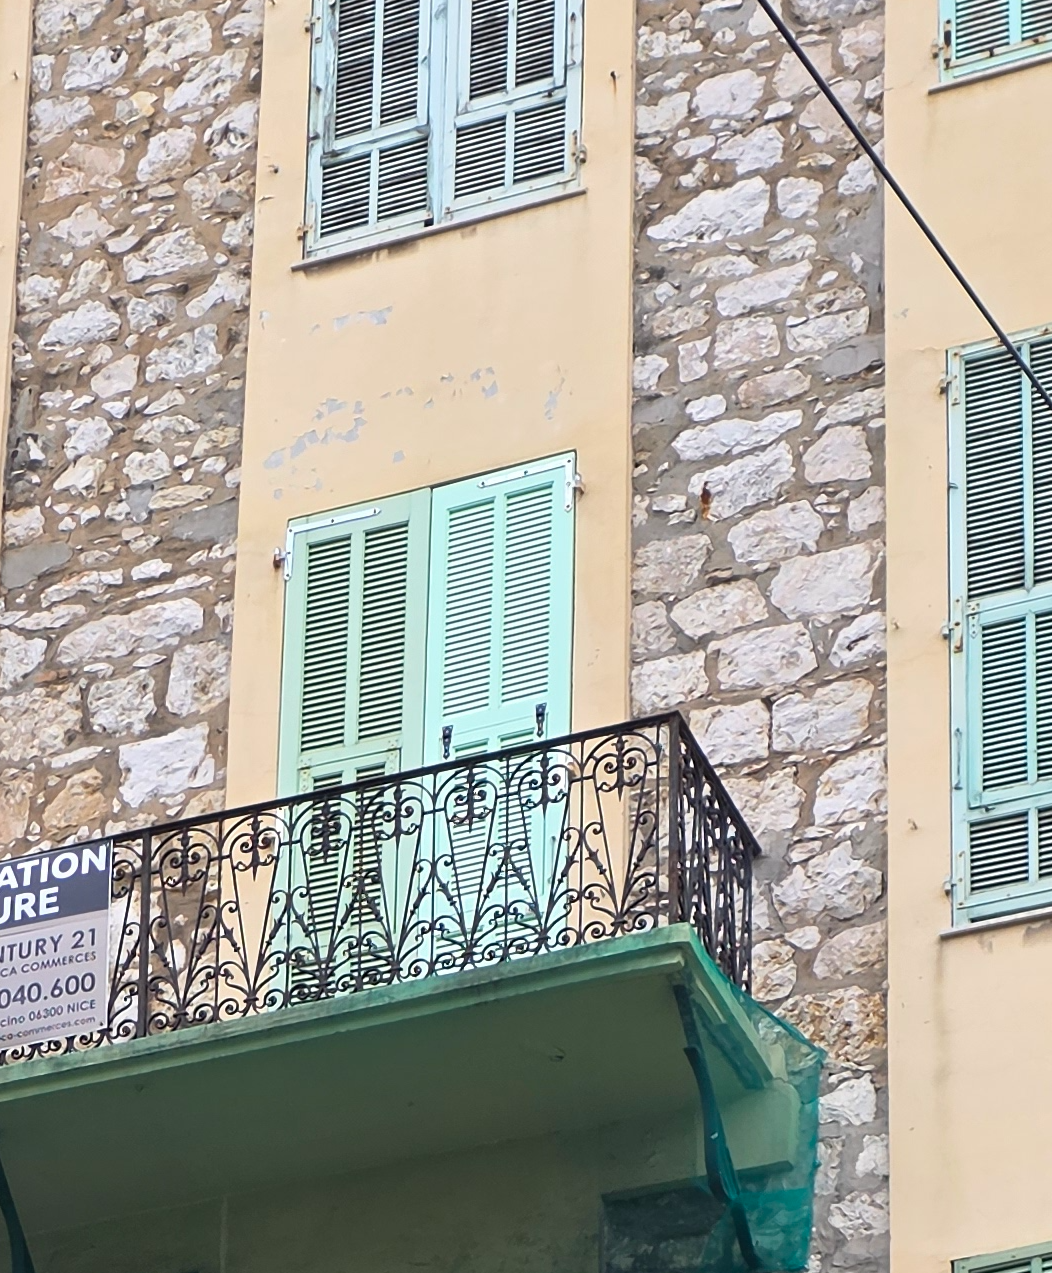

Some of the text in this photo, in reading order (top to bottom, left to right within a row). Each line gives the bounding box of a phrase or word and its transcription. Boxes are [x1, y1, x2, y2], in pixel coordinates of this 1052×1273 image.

[71, 928, 97, 950] 21
[20, 950, 97, 974] COMMERCES
[28, 1007, 64, 1023] 06300
[67, 999, 97, 1014] NICE
